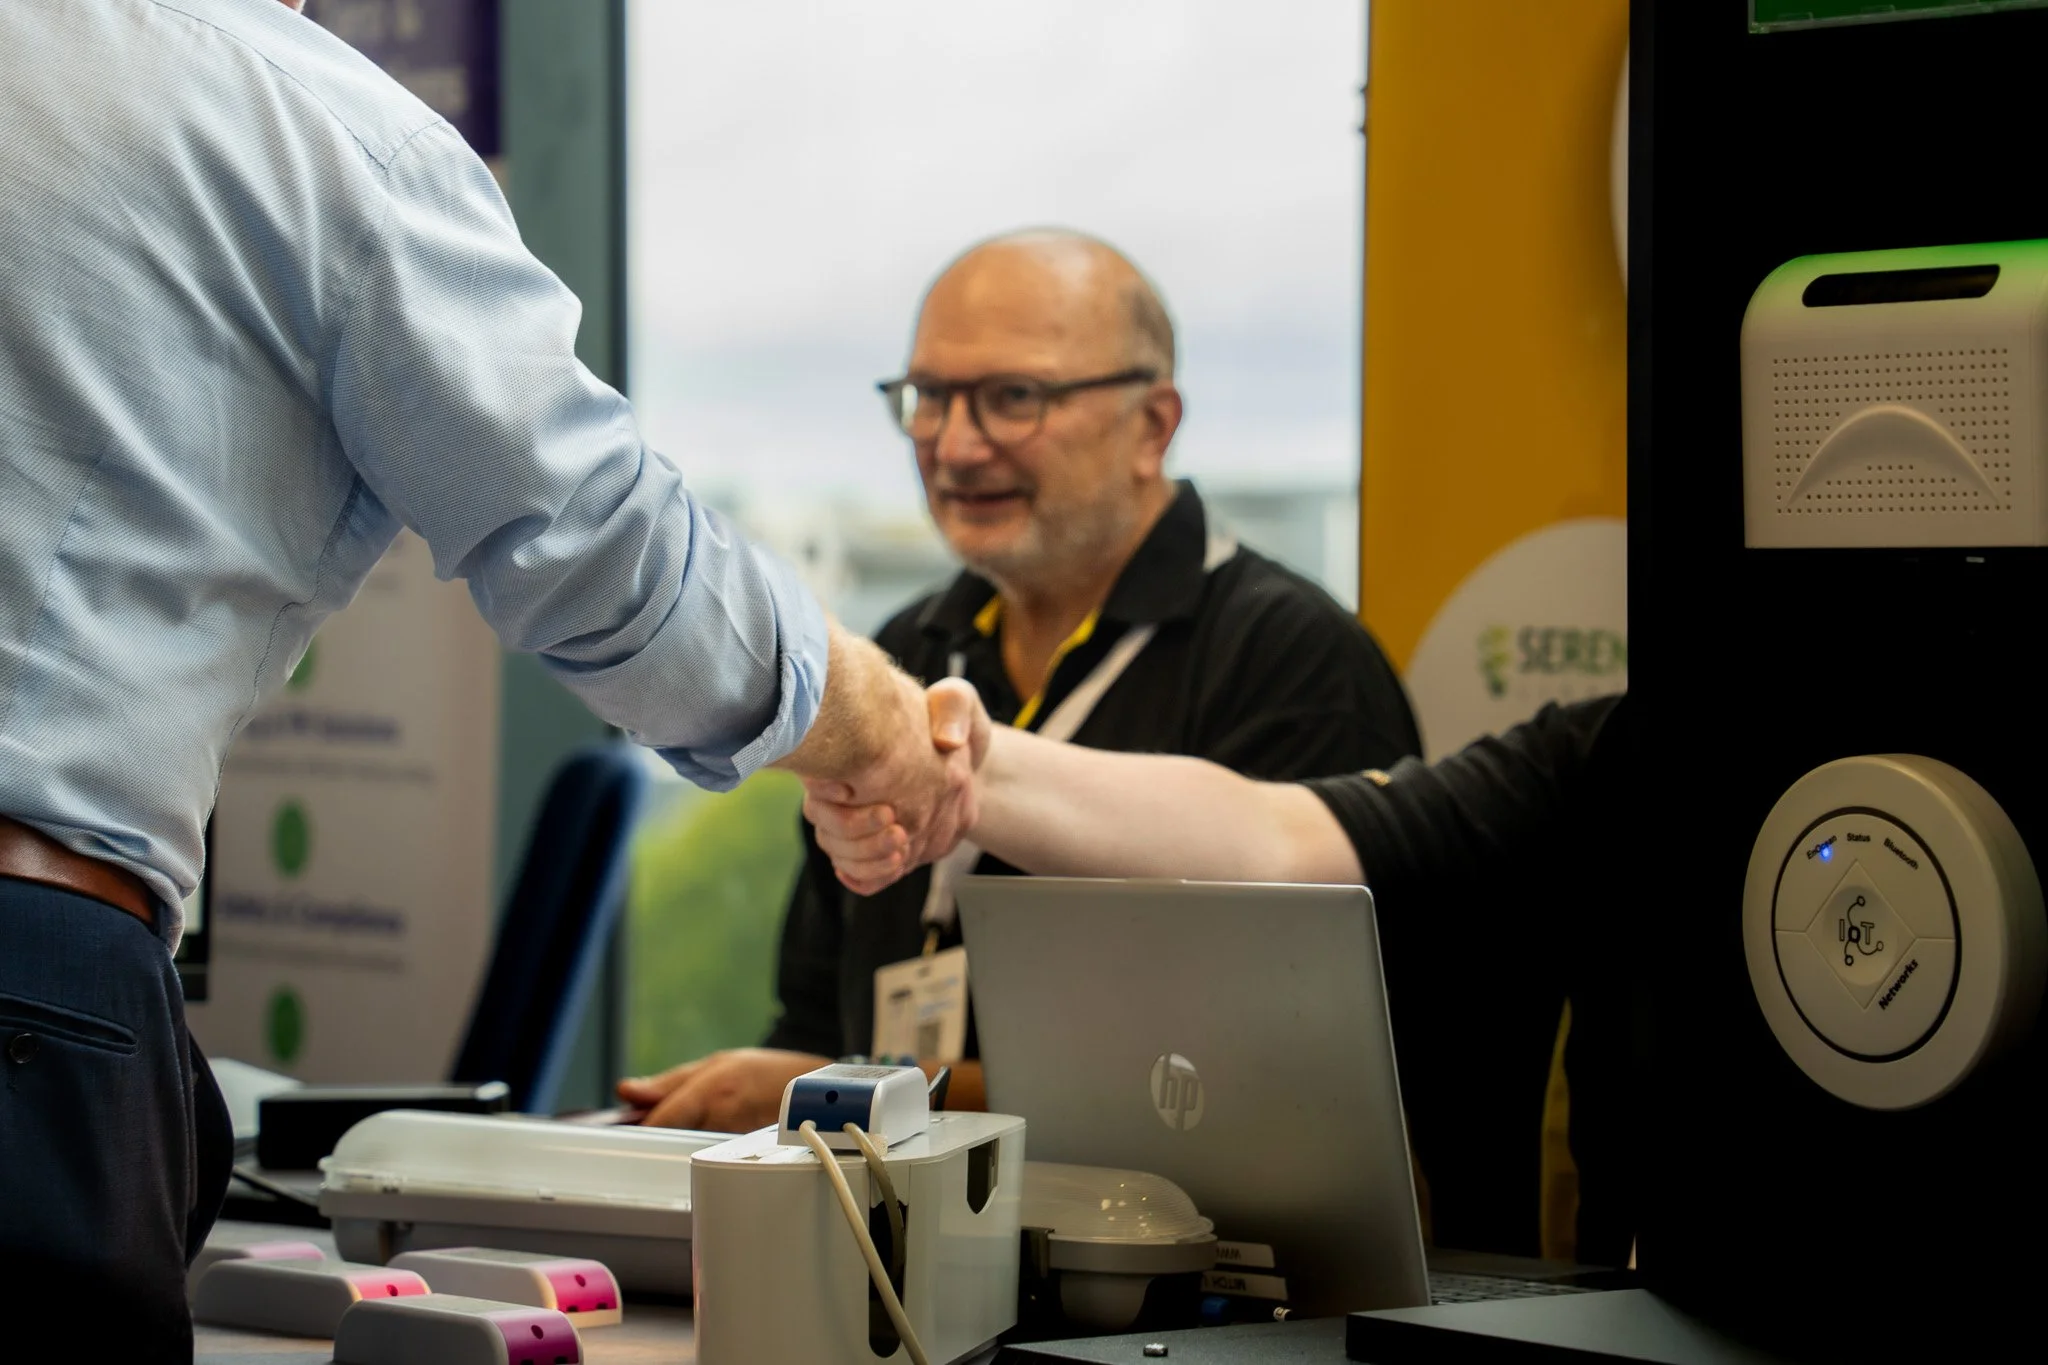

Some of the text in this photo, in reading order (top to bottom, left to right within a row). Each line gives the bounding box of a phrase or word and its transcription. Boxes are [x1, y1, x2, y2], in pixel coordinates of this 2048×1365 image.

[1847, 833, 1871, 842] Status
[1883, 838, 1919, 870] Bluetooth
[1878, 959, 1919, 1010] Networks
[1152, 1052, 1203, 1131] hp
